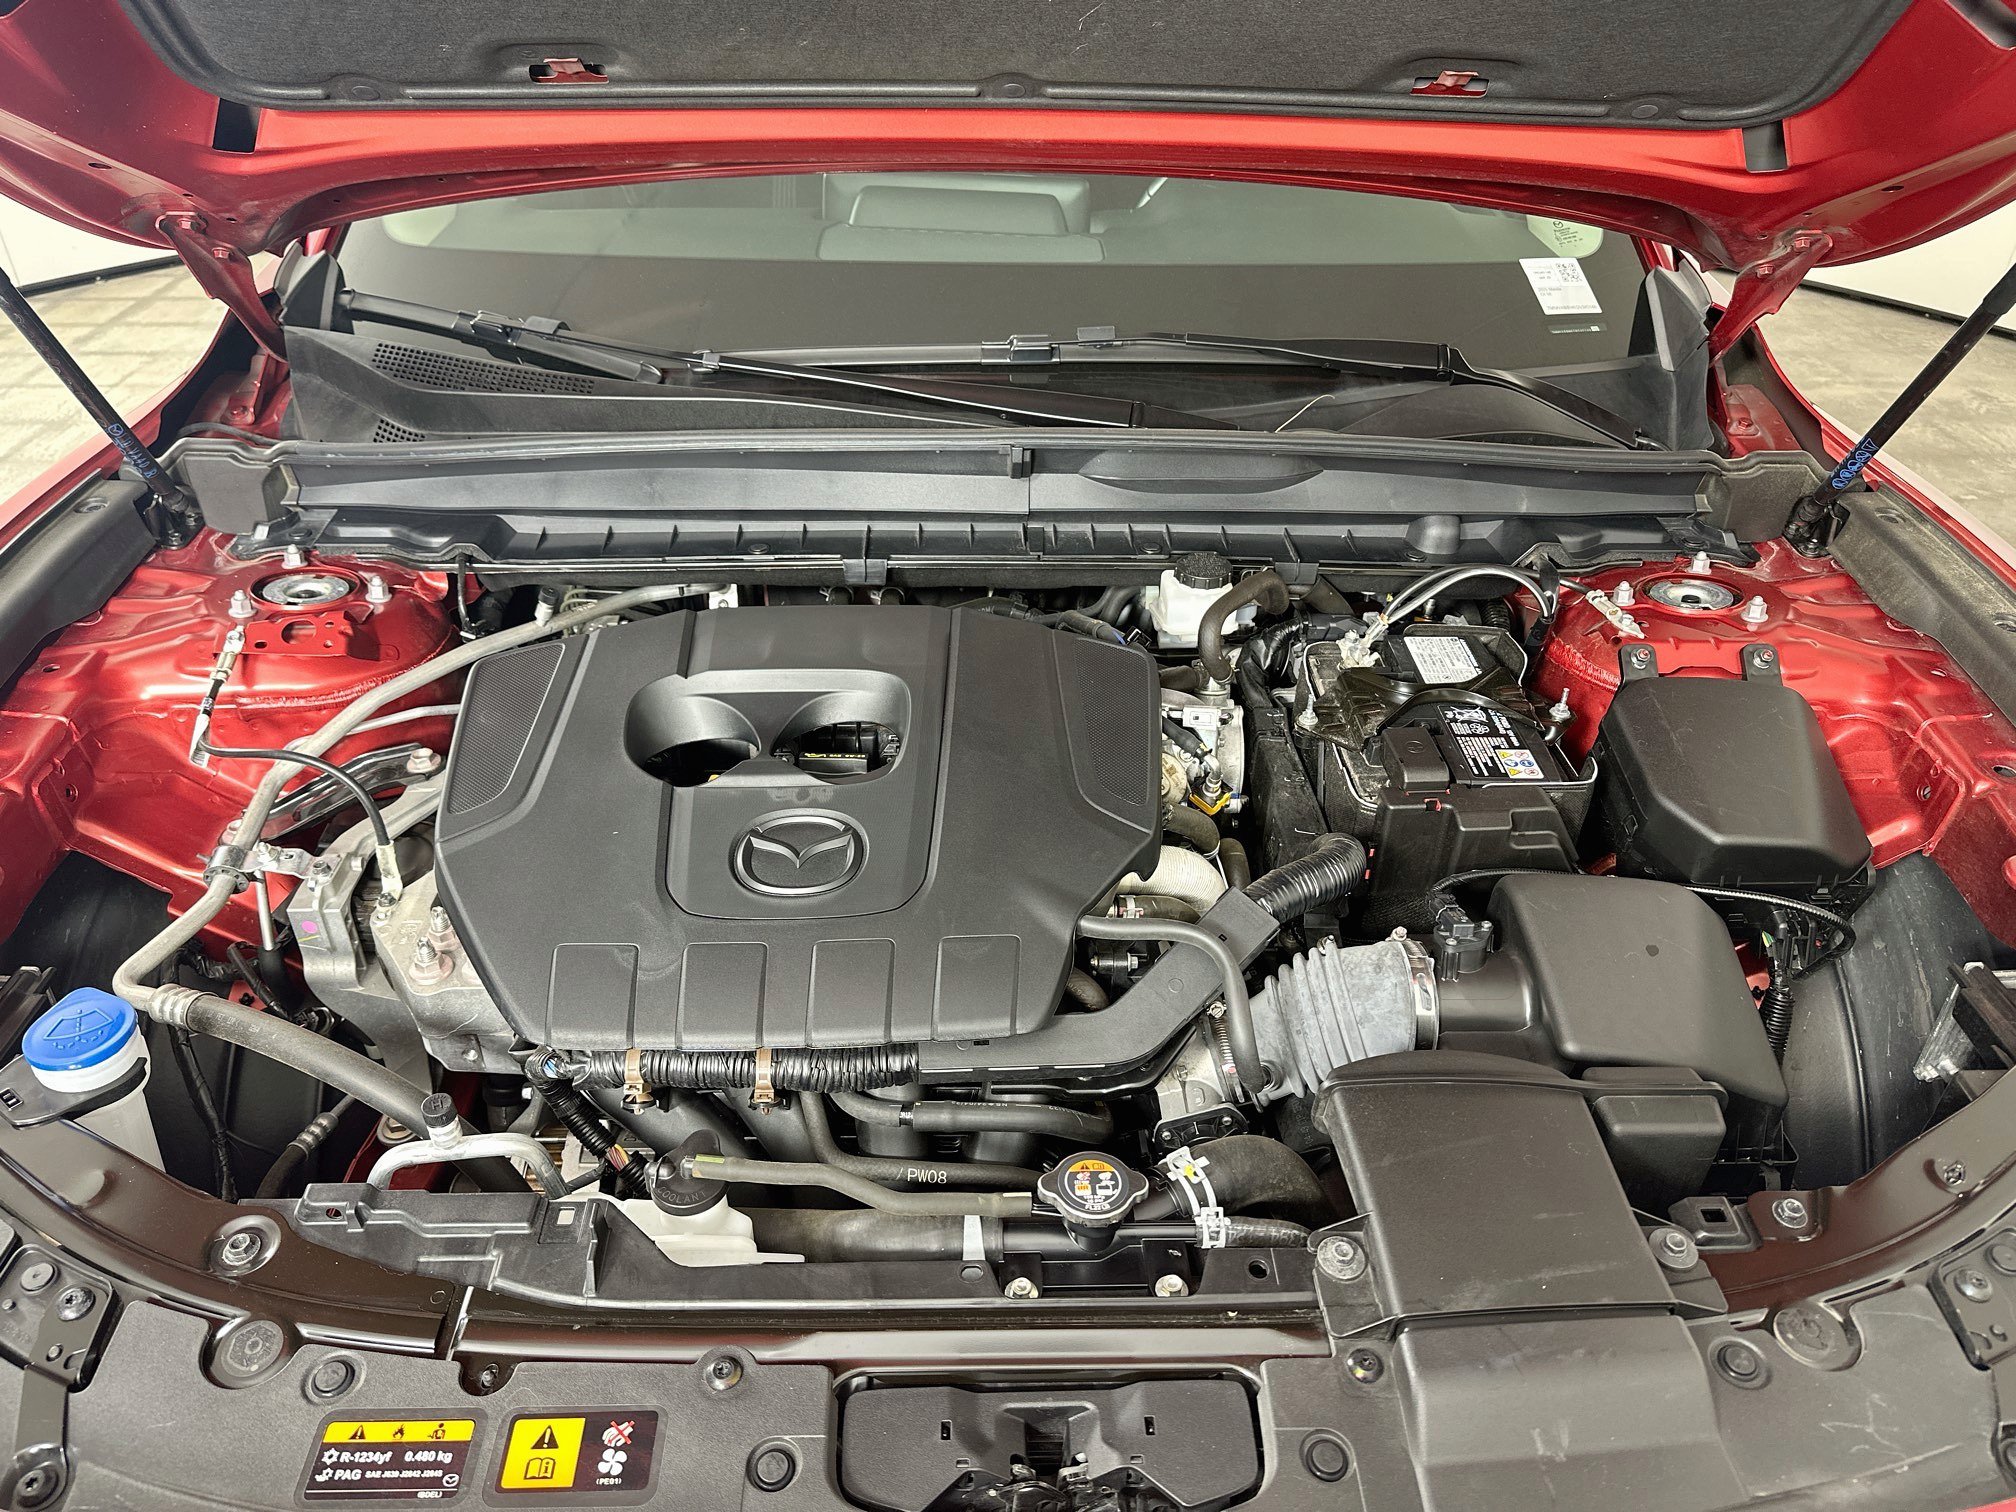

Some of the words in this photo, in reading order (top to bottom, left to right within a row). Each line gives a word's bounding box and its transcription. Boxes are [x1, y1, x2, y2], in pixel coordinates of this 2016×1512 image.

[907, 1168, 947, 1184] PW08
[658, 1186, 706, 1203] COOLANT
[339, 1451, 393, 1464] R-1234yf
[404, 1451, 436, 1463] 0.480
[437, 1451, 453, 1463] kg
[334, 1469, 362, 1480] PAG
[365, 1470, 382, 1478] SAE
[596, 1477, 622, 1485] (PE01)
